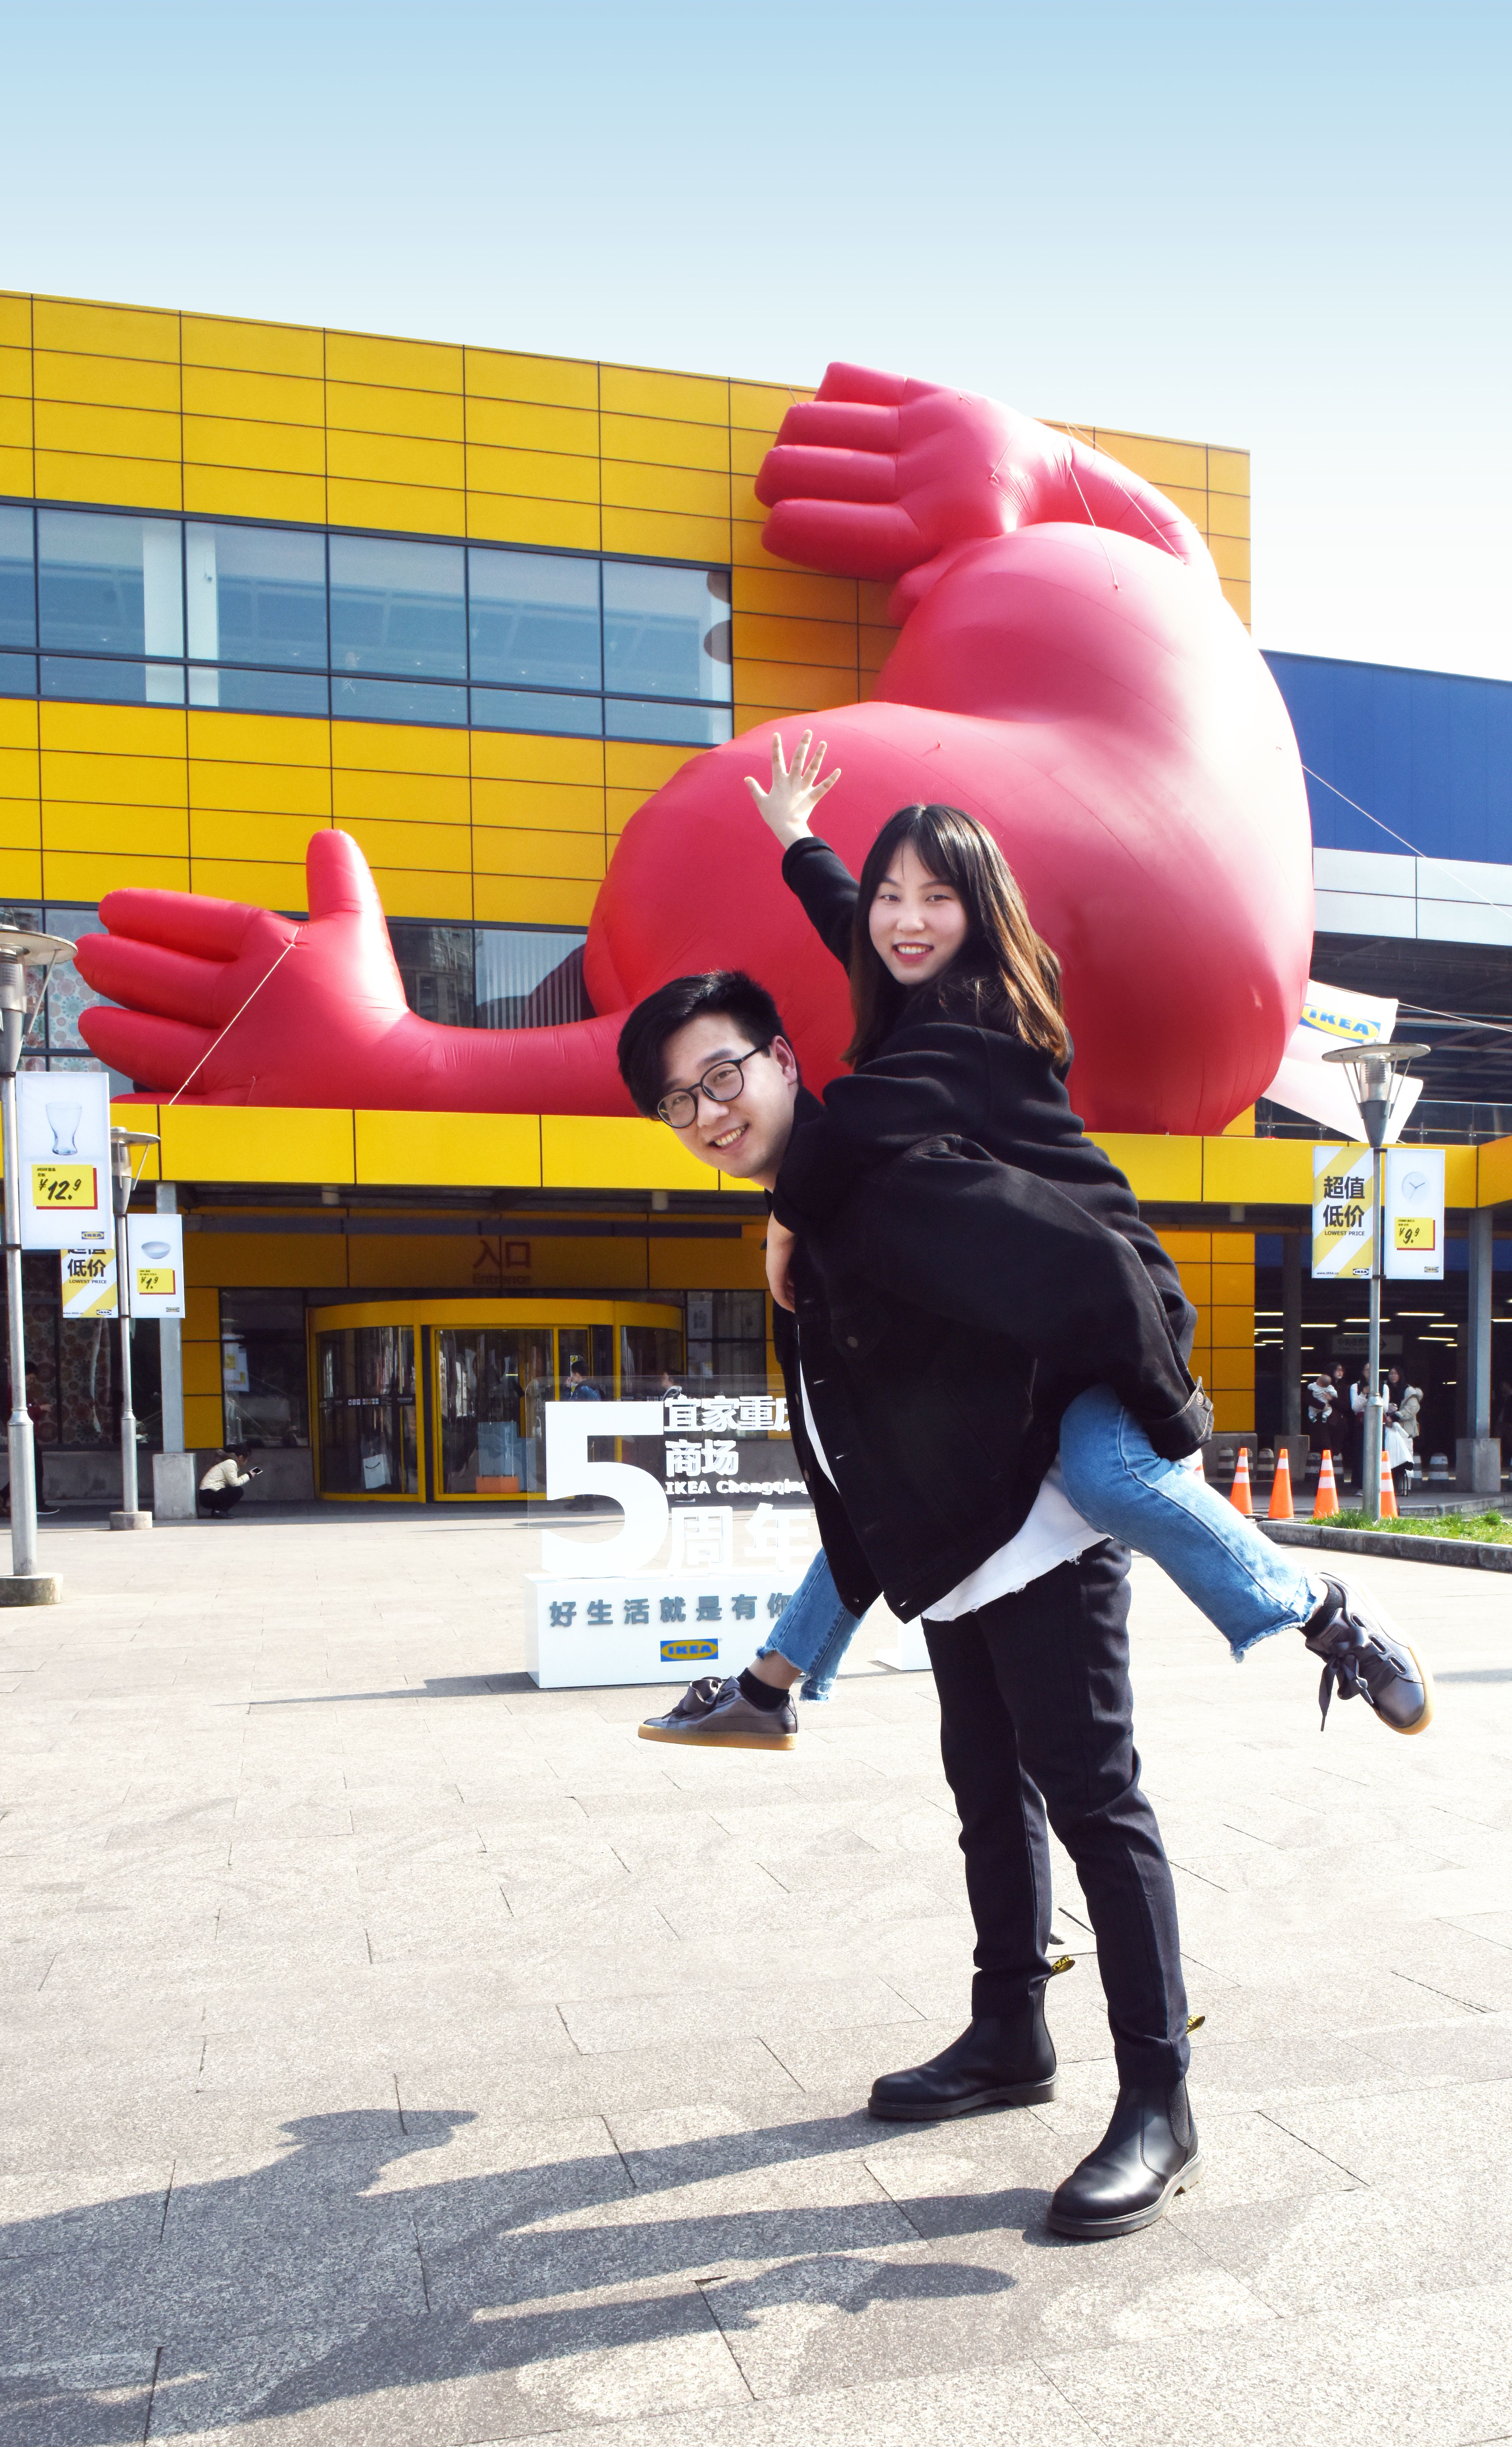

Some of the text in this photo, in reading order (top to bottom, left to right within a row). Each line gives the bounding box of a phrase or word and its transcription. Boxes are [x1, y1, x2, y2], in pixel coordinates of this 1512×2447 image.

[1309, 1009, 1369, 1036] IKEA
[1324, 1176, 1365, 1199] 超值
[1323, 1205, 1365, 1228] 低价
[473, 1239, 531, 1269] 入口
[67, 1259, 106, 1277] 低价
[665, 1439, 739, 1477] 商场
[542, 1401, 669, 1573] 5
[665, 1478, 809, 1495] IKEA Chongqing
[668, 1644, 713, 1655] IKEA
